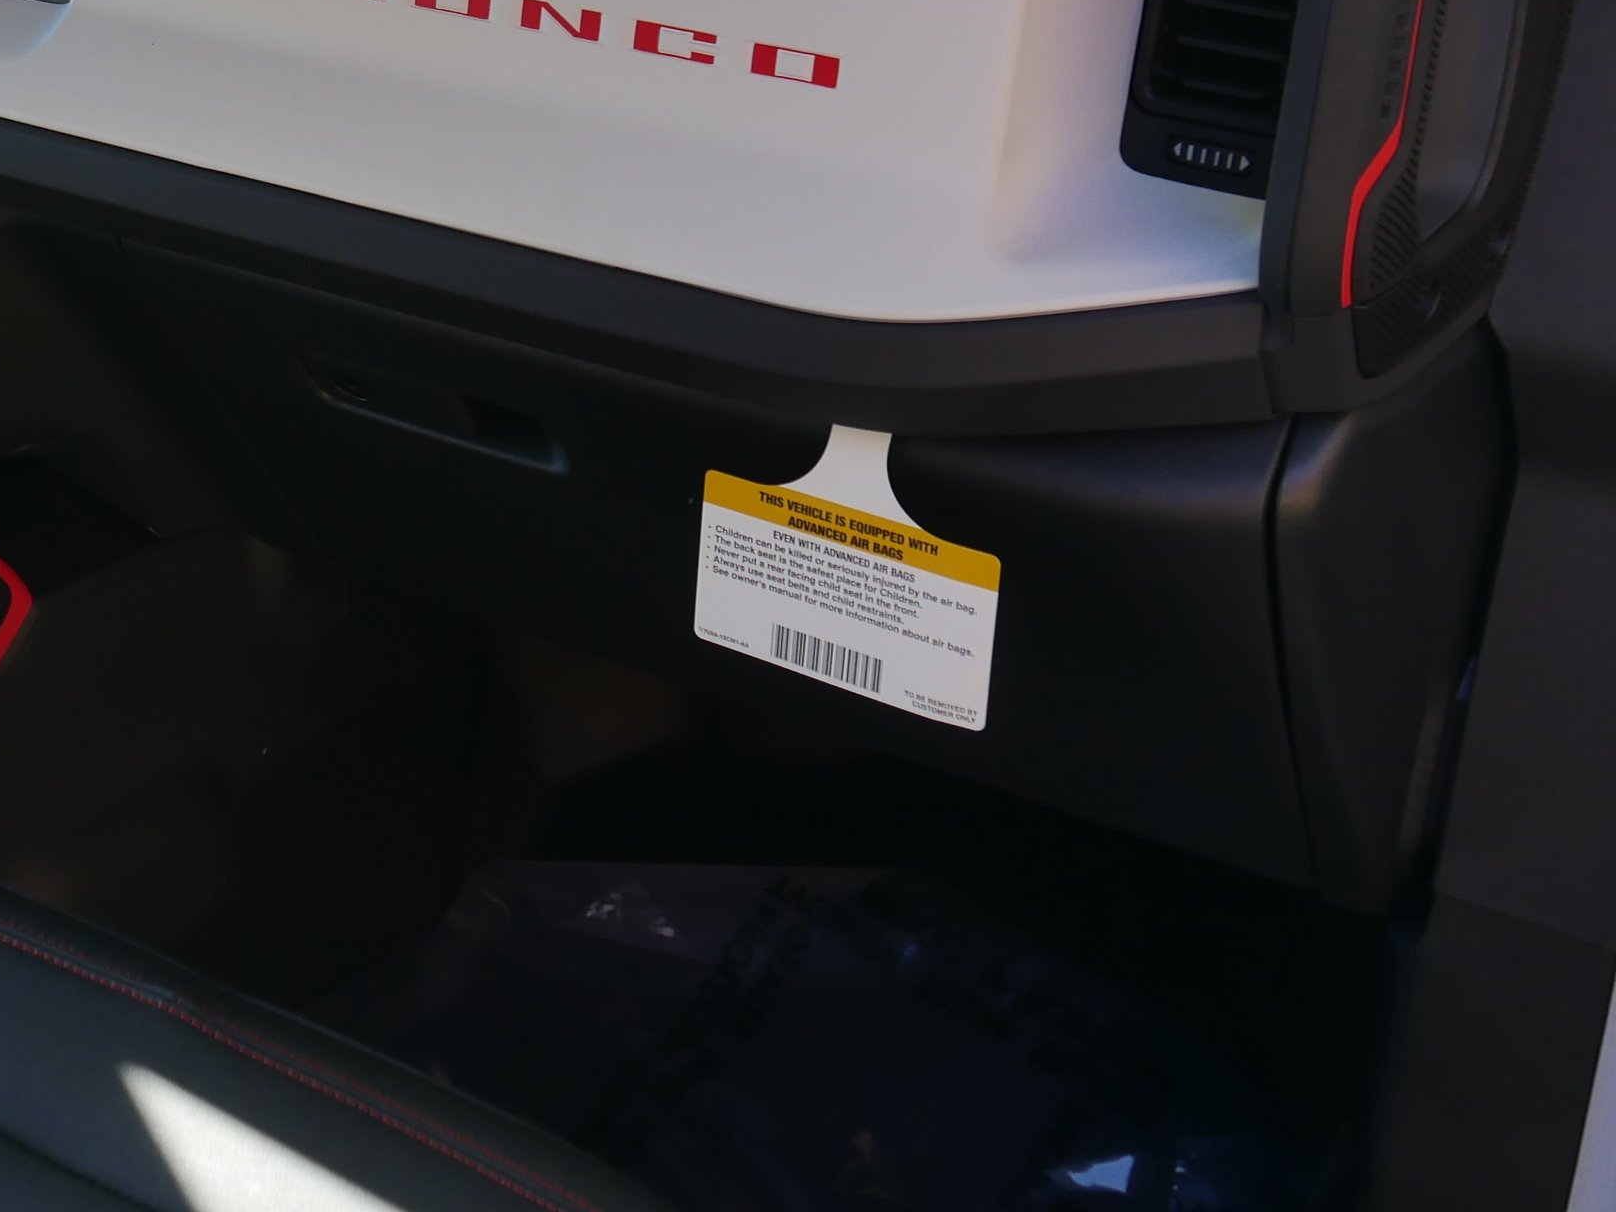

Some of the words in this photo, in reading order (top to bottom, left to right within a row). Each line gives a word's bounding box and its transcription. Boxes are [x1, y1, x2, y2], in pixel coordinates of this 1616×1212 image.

[759, 491, 784, 508] THIS
[787, 499, 832, 523] VEHICLE
[835, 514, 846, 527] IS
[849, 519, 905, 545] EQUIPPED
[908, 536, 939, 556] WITH
[773, 530, 796, 545] EVEN
[798, 537, 821, 553] WITH
[823, 546, 870, 569] ADVANCED
[873, 561, 888, 575] AIR
[891, 567, 916, 583] BAGS
[787, 516, 847, 542] ADVANCED
[850, 535, 869, 550] AIR
[873, 543, 904, 561] BAGS
[713, 555, 745, 573] Always
[748, 567, 764, 578] use
[767, 574, 785, 586] seat
[788, 580, 810, 593] belts
[812, 588, 830, 599] and
[832, 594, 855, 608] child
[857, 603, 904, 624] restraints.
[714, 545, 739, 560] Never
[742, 555, 757, 566] put
[759, 560, 765, 568] a
[767, 563, 785, 574] rear
[787, 569, 816, 586] facing
[818, 579, 841, 593] child
[843, 587, 863, 600] seat
[865, 594, 874, 603] in
[876, 598, 892, 609] the
[894, 603, 919, 619] front.
[715, 525, 753, 543] Children
[756, 540, 772, 549] can
[775, 543, 786, 553] be
[789, 547, 813, 563] killed
[815, 557, 825, 566] or
[827, 561, 870, 581] seriously
[872, 574, 906, 592] injured
[908, 587, 920, 599] by
[922, 592, 938, 603] the
[940, 597, 953, 607] air
[956, 601, 977, 616] bag.
[715, 535, 732, 546] The
[734, 541, 755, 554] back
[758, 549, 777, 560] seat
[779, 555, 787, 564] is
[789, 558, 804, 570] the
[806, 565, 834, 579] safest
[836, 574, 862, 588] place
[864, 583, 877, 593] for
[880, 588, 923, 609] Children.
[712, 565, 730, 577] See
[731, 572, 767, 589] owner's
[769, 584, 802, 601] manual
[805, 595, 817, 606] for
[820, 601, 843, 615] more
[846, 609, 900, 633] information
[902, 629, 930, 644] about
[932, 638, 945, 648] air
[948, 643, 975, 658] bags.
[904, 690, 915, 699] TO
[916, 694, 926, 703] BE
[927, 697, 966, 714] REMOVED
[967, 709, 978, 717] BY
[912, 700, 954, 718] CUSTOMER
[955, 713, 976, 724] ONLY
